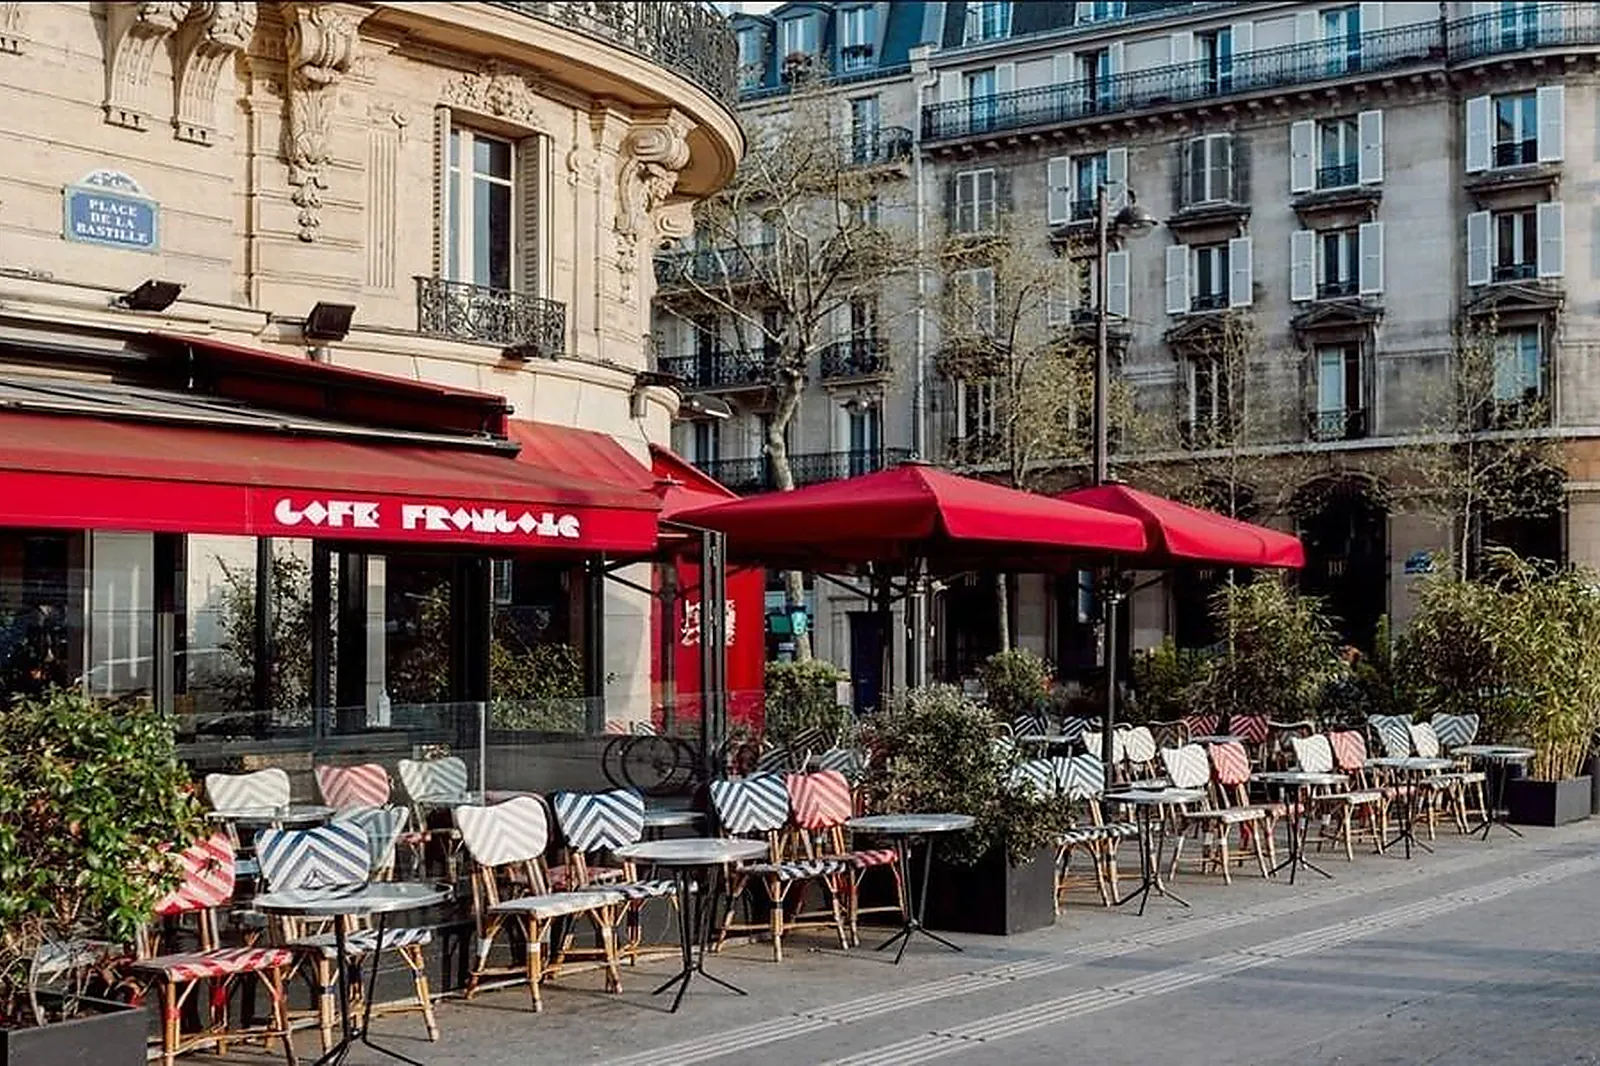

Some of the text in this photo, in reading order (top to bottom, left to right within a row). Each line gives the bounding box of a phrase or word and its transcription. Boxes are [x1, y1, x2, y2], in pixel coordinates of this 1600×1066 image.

[89, 199, 137, 217] PLACE
[91, 212, 135, 229] DE LA
[76, 222, 148, 243] BASTILLE
